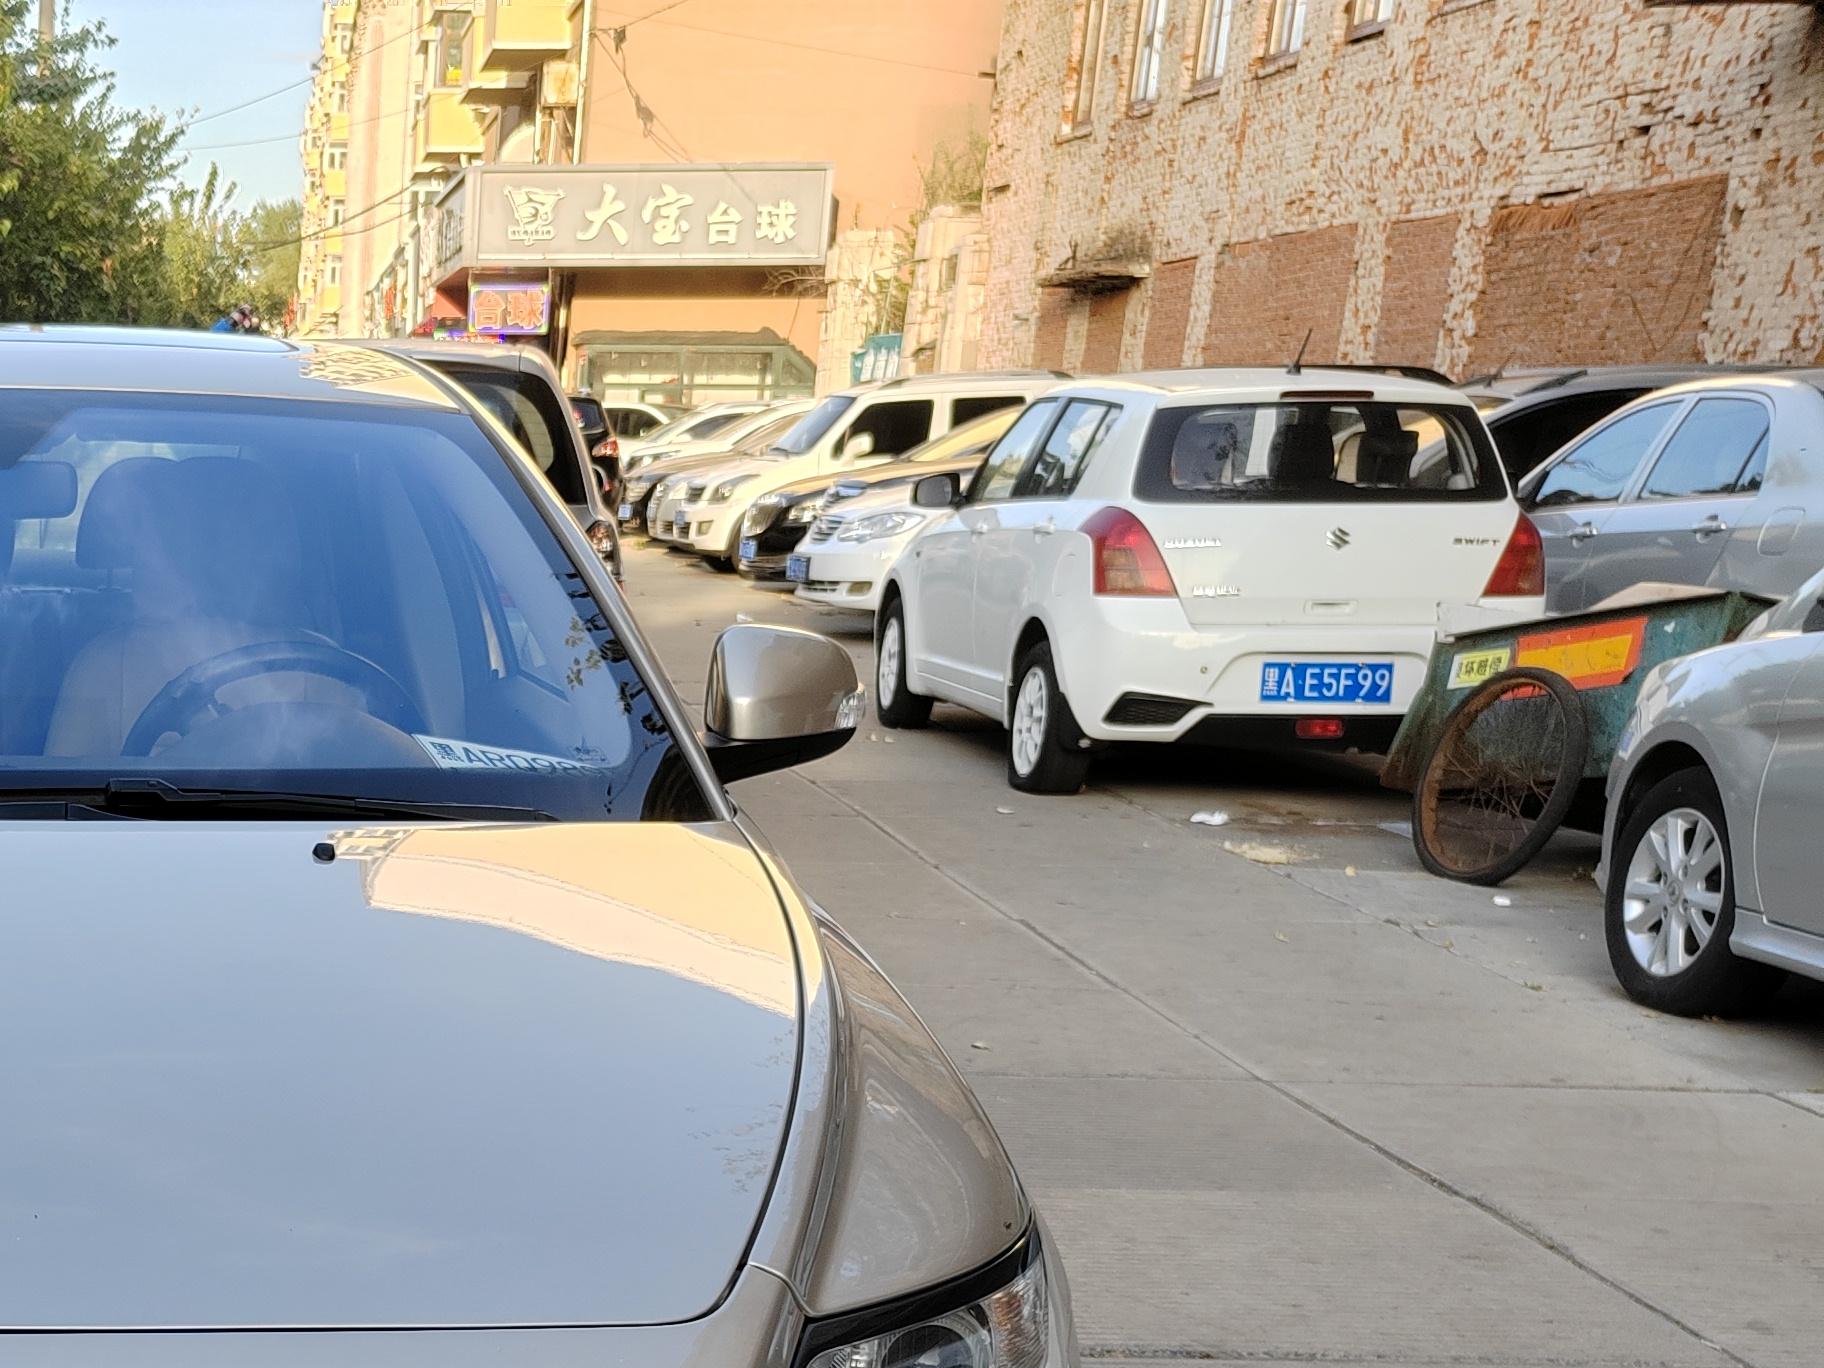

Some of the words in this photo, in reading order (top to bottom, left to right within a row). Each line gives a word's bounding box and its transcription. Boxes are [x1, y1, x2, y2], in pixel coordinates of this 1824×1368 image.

[576, 183, 799, 245] 大宝台球
[474, 290, 544, 329] 台球
[1452, 536, 1501, 547] SWIFT
